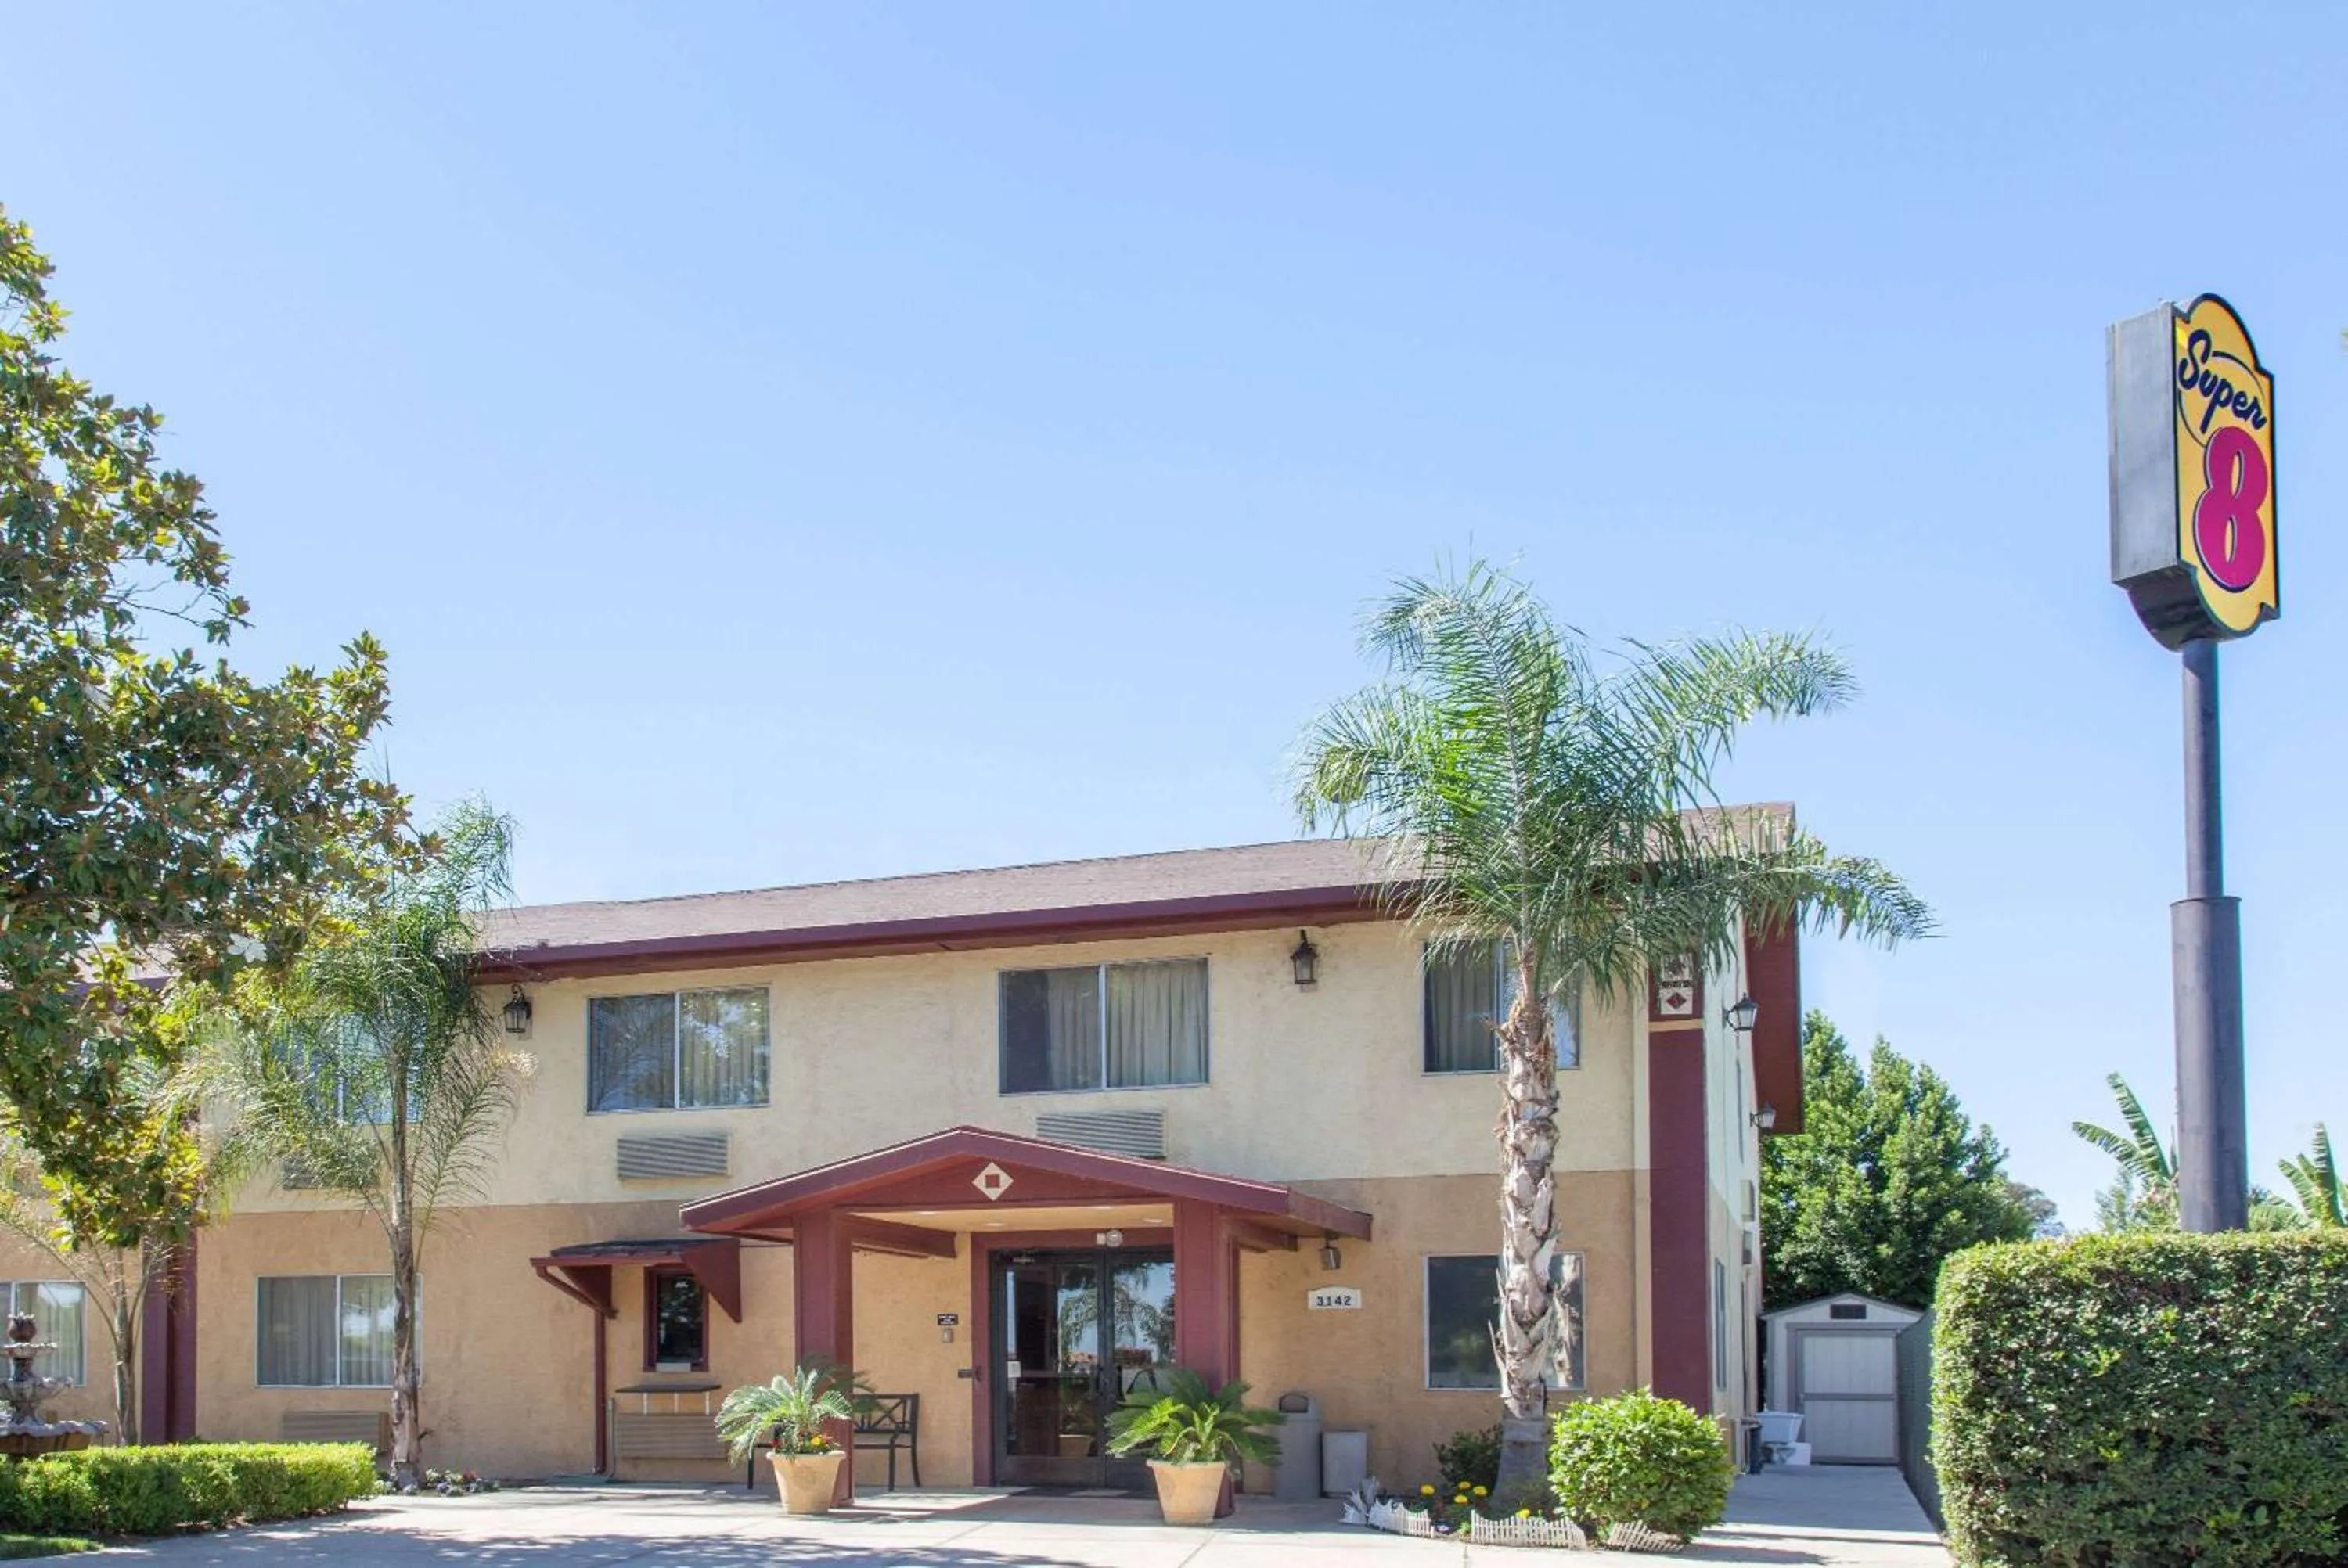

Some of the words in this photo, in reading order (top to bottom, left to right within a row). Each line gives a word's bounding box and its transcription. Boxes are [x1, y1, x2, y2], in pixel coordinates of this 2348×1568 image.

[2178, 329, 2267, 434] Super
[2193, 426, 2268, 593] 8
[1316, 1295, 1352, 1306] 3142
